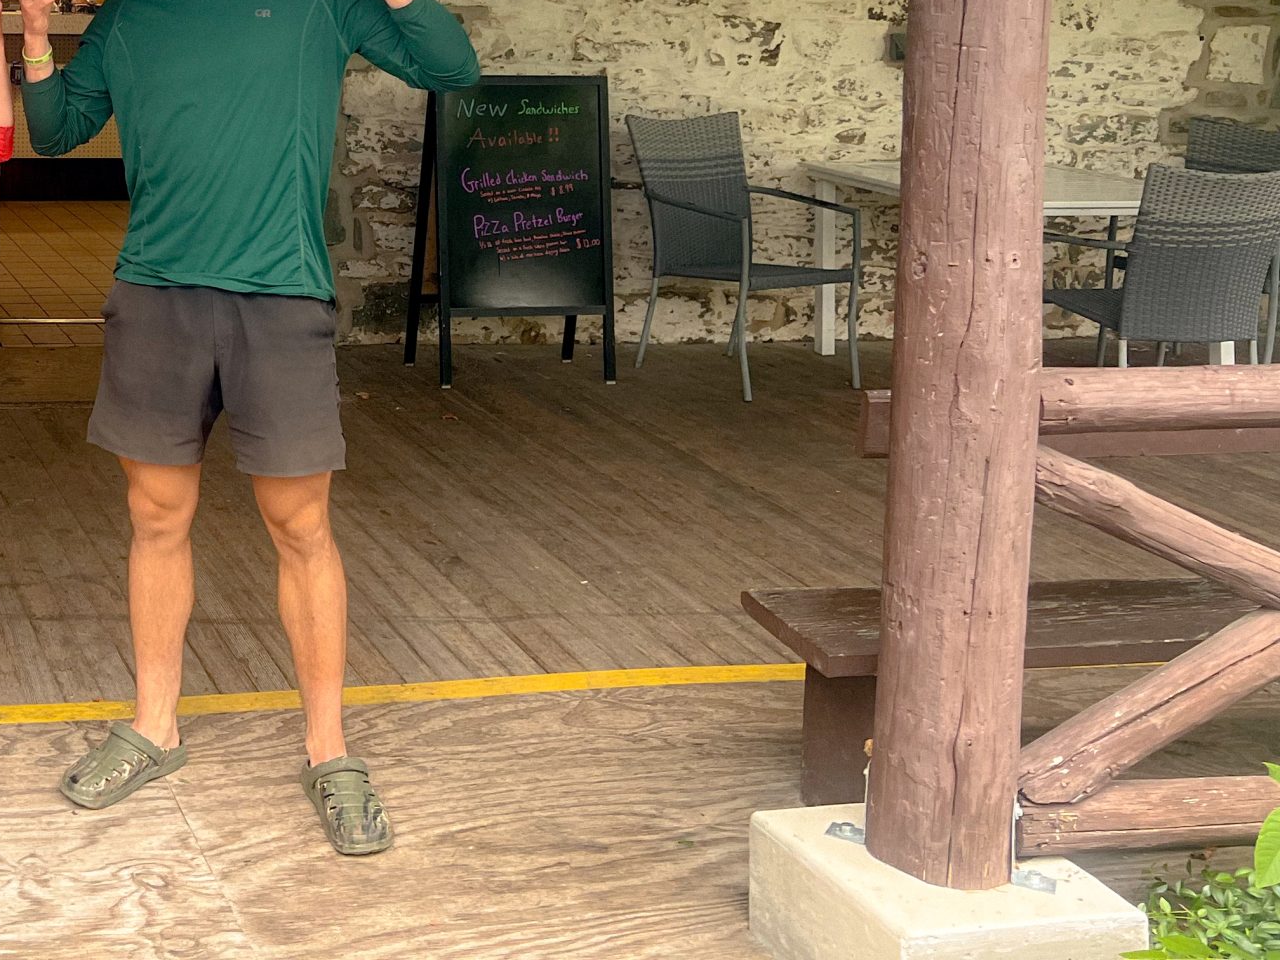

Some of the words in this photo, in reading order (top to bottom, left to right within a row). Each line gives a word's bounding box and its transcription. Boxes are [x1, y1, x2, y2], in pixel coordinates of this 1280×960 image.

[457, 99, 507, 118] New
[517, 99, 580, 116] Sandwiches
[466, 127, 543, 149] Available
[461, 167, 501, 193] Grilled
[505, 169, 538, 185] Chicken
[541, 169, 589, 182] Sandwich
[513, 211, 553, 232] Pretzel
[556, 207, 584, 226] Burger
